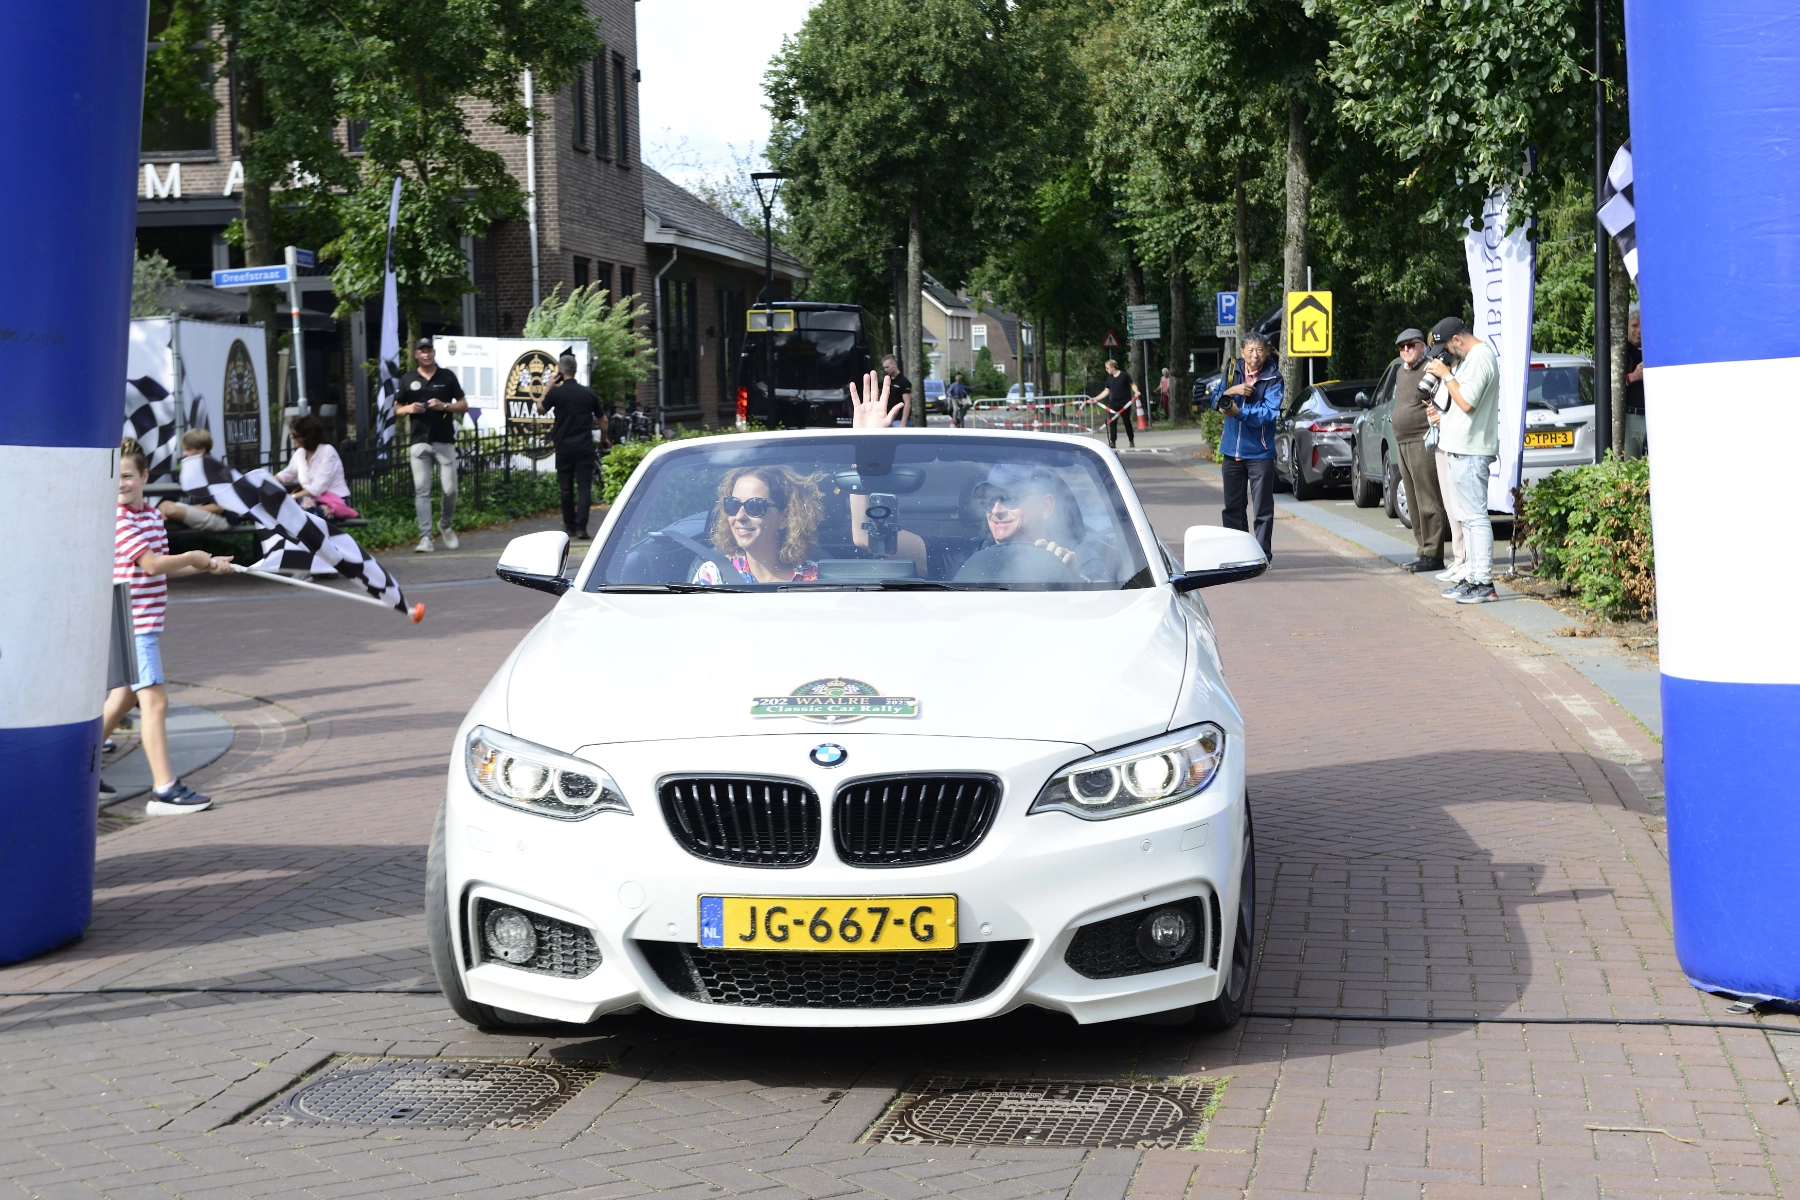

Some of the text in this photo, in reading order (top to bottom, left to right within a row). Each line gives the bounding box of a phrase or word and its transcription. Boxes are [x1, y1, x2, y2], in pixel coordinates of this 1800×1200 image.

[221, 270, 281, 284] Dreefstraat
[1221, 294, 1236, 314] P
[1301, 321, 1319, 342] K
[226, 419, 258, 443] WAALRE
[1523, 432, 1568, 445] 0-TPH-3
[795, 697, 870, 705] WAALRE
[765, 705, 823, 713] Classic
[859, 705, 903, 714] Rally
[738, 905, 935, 943] JG-667-G
[703, 926, 721, 939] NL
